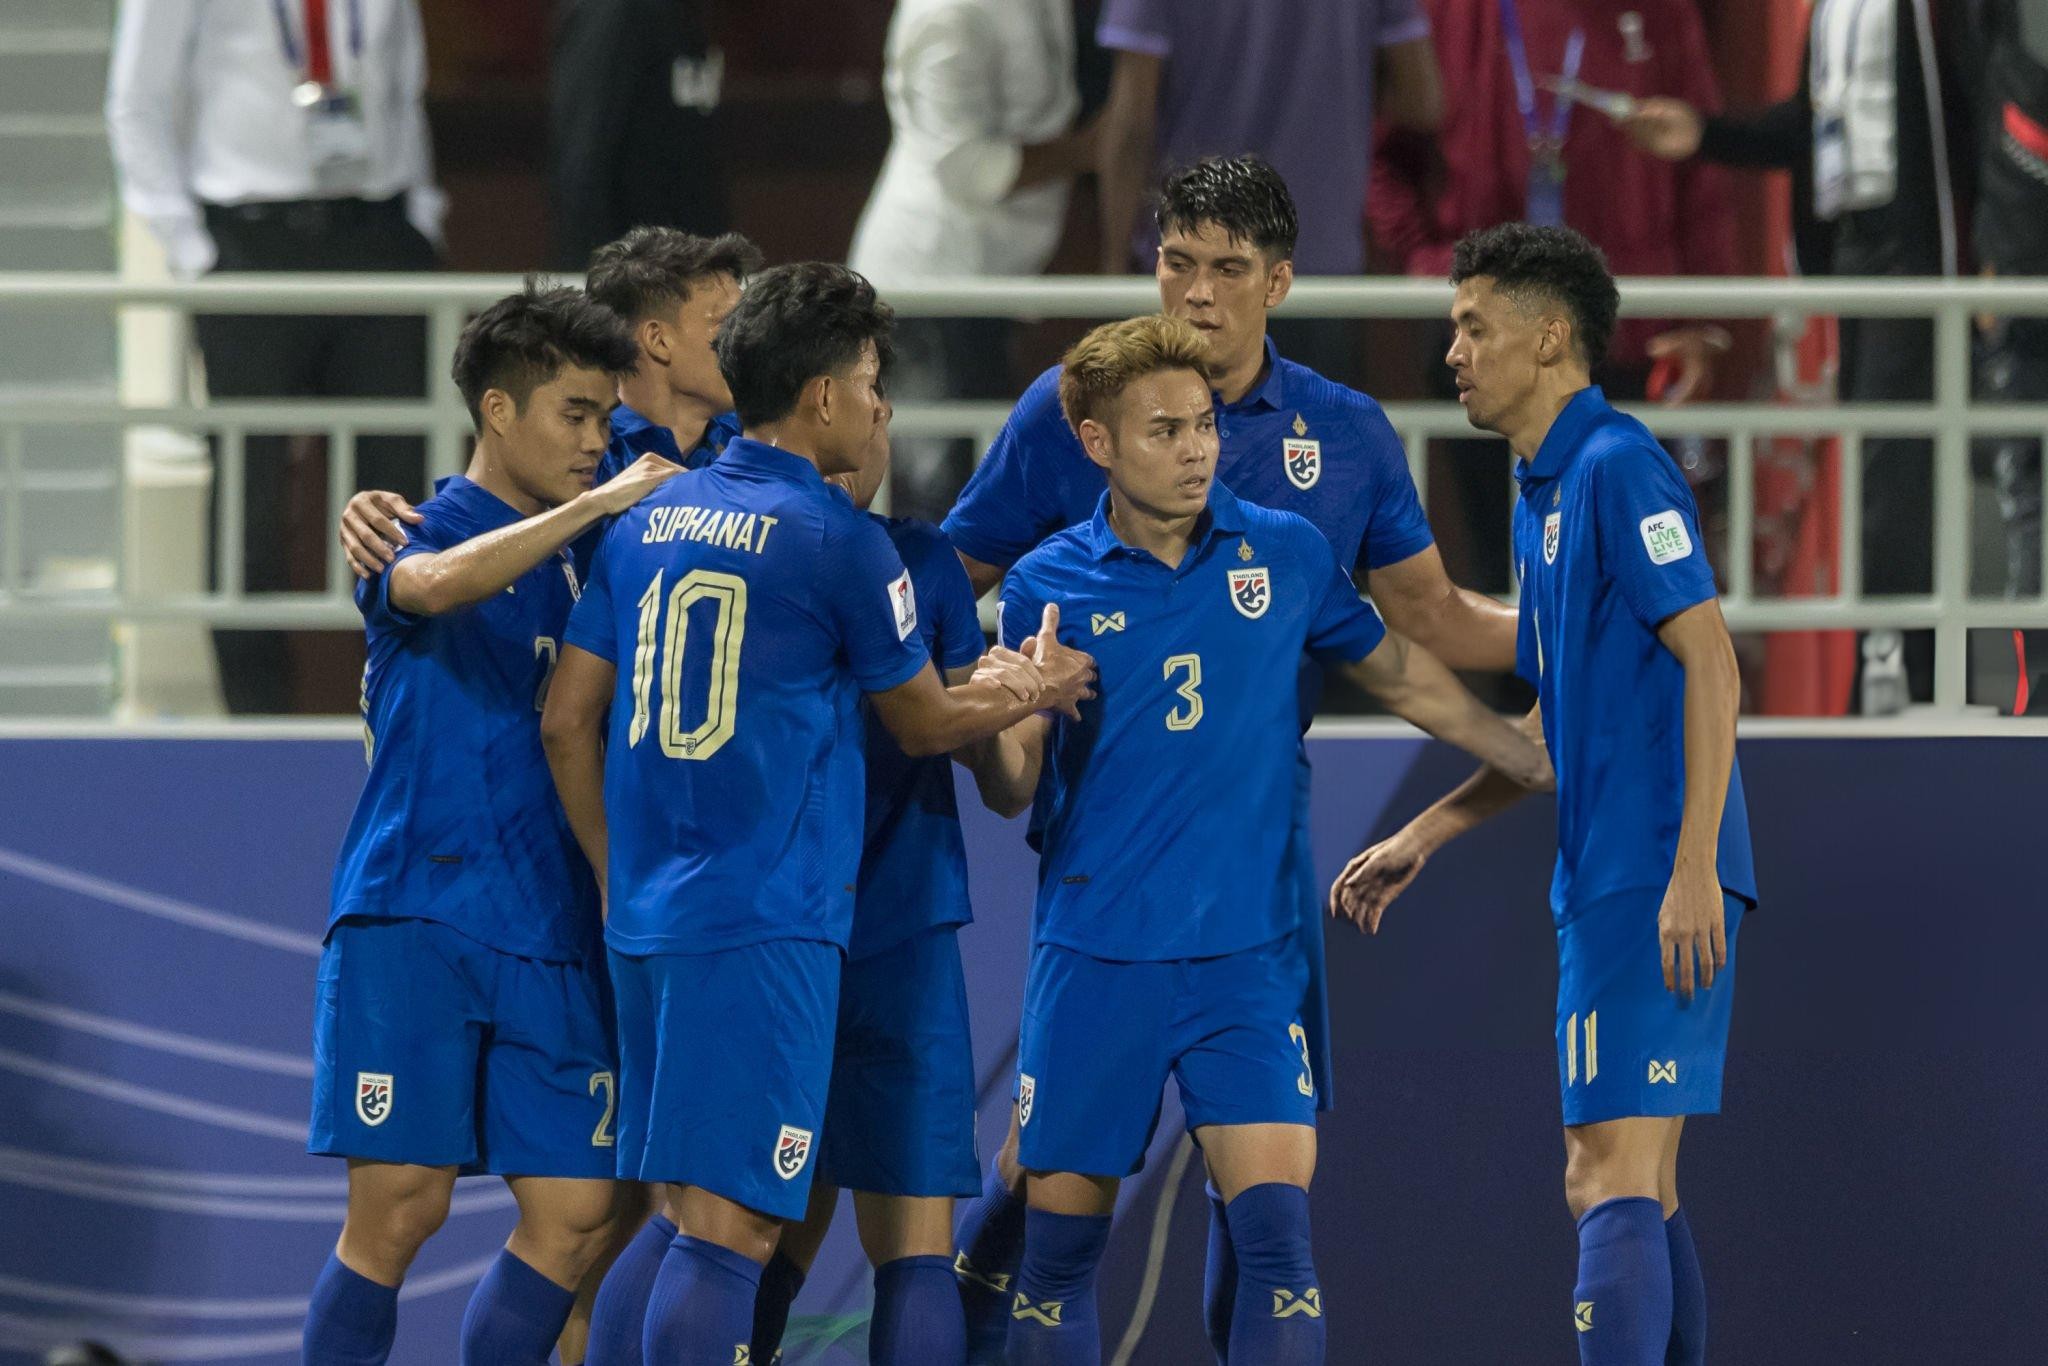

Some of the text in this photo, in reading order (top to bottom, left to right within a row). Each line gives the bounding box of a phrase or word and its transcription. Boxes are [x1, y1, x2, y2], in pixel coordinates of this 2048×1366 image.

[642, 506, 779, 554] SUPHANAT
[1648, 522, 1664, 533] AFC
[1650, 527, 1680, 545] LIVE
[1232, 572, 1264, 580] THAILAND
[629, 567, 747, 761] 10
[1163, 653, 1204, 731] 3
[1288, 1022, 1313, 1098] 3
[1566, 1009, 1598, 1088] 11
[589, 1071, 615, 1147] 2
